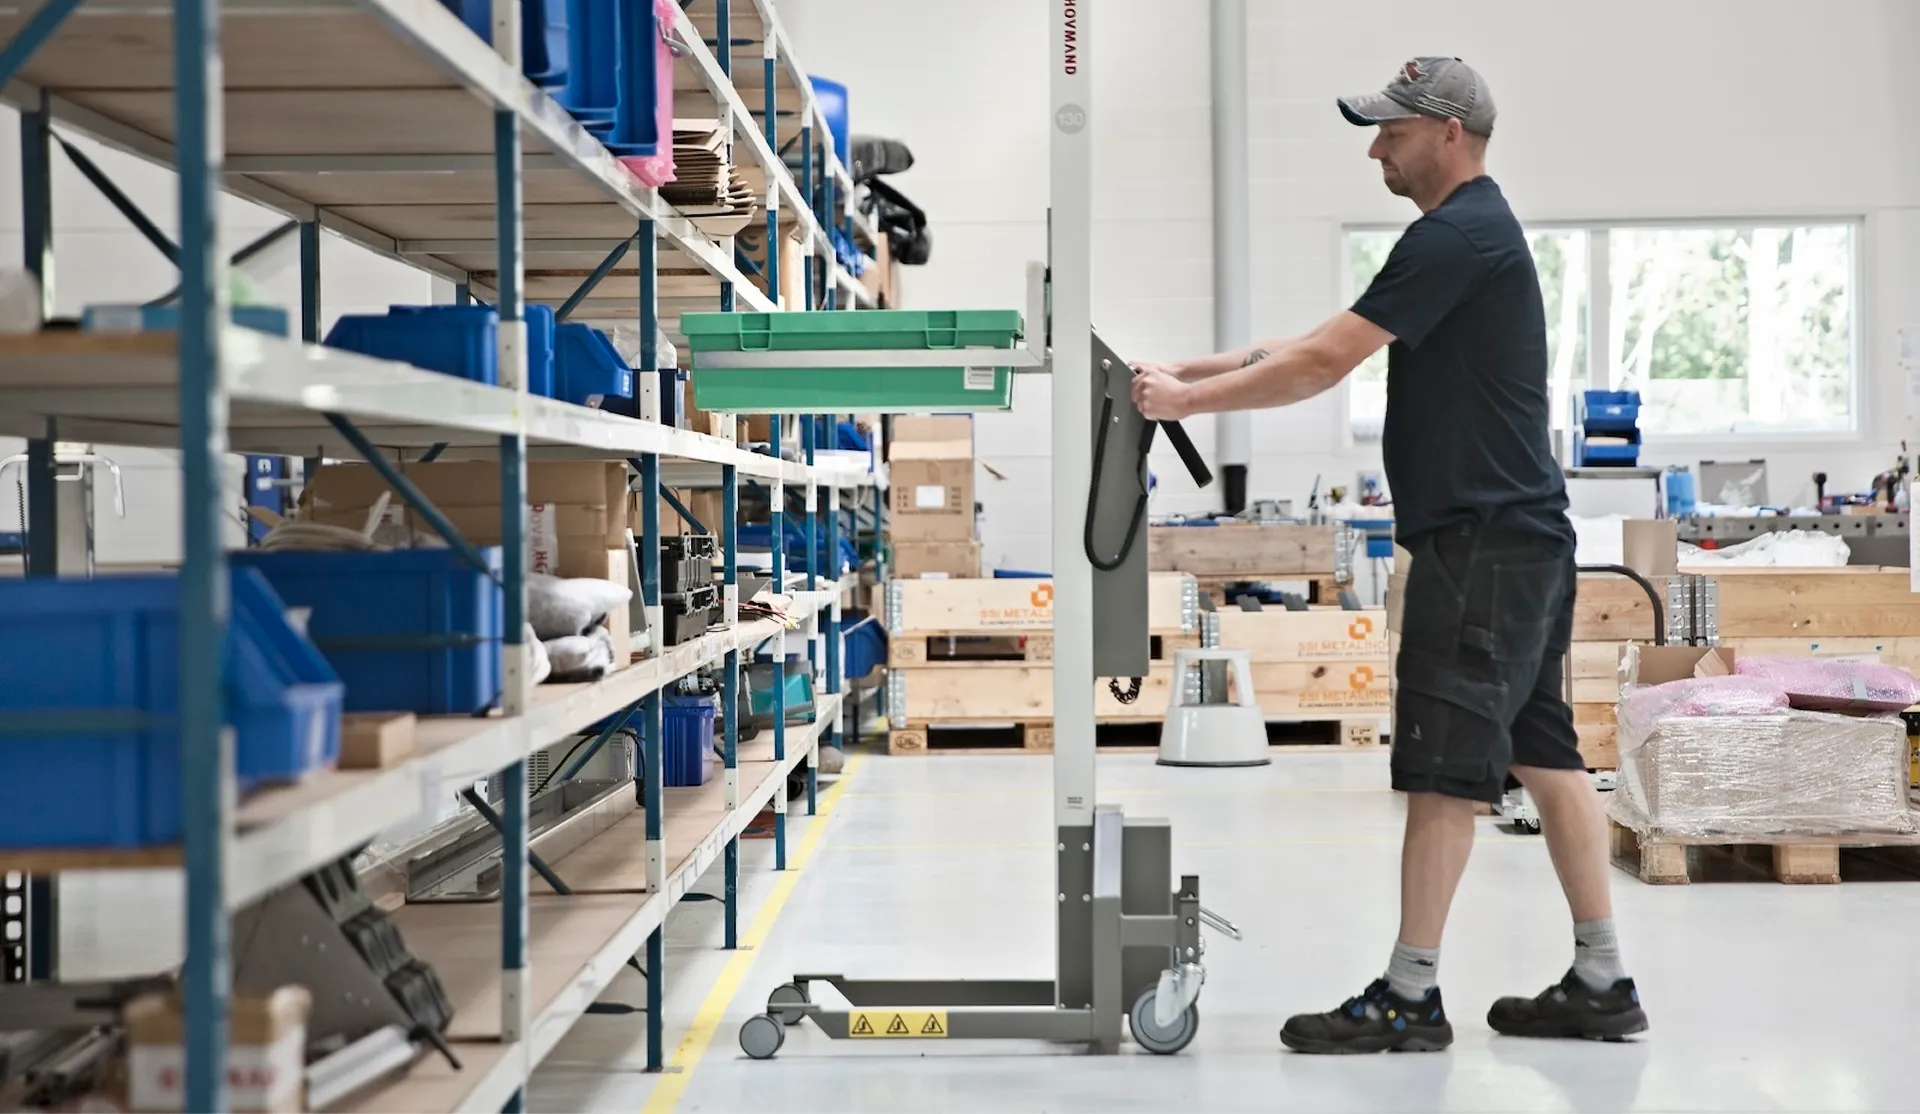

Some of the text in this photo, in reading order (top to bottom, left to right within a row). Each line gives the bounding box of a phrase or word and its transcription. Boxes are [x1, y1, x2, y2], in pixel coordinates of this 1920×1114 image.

[1064, 0, 1076, 75] HOVMAND
[1057, 112, 1083, 126] 130
[1298, 640, 1318, 651] SSI
